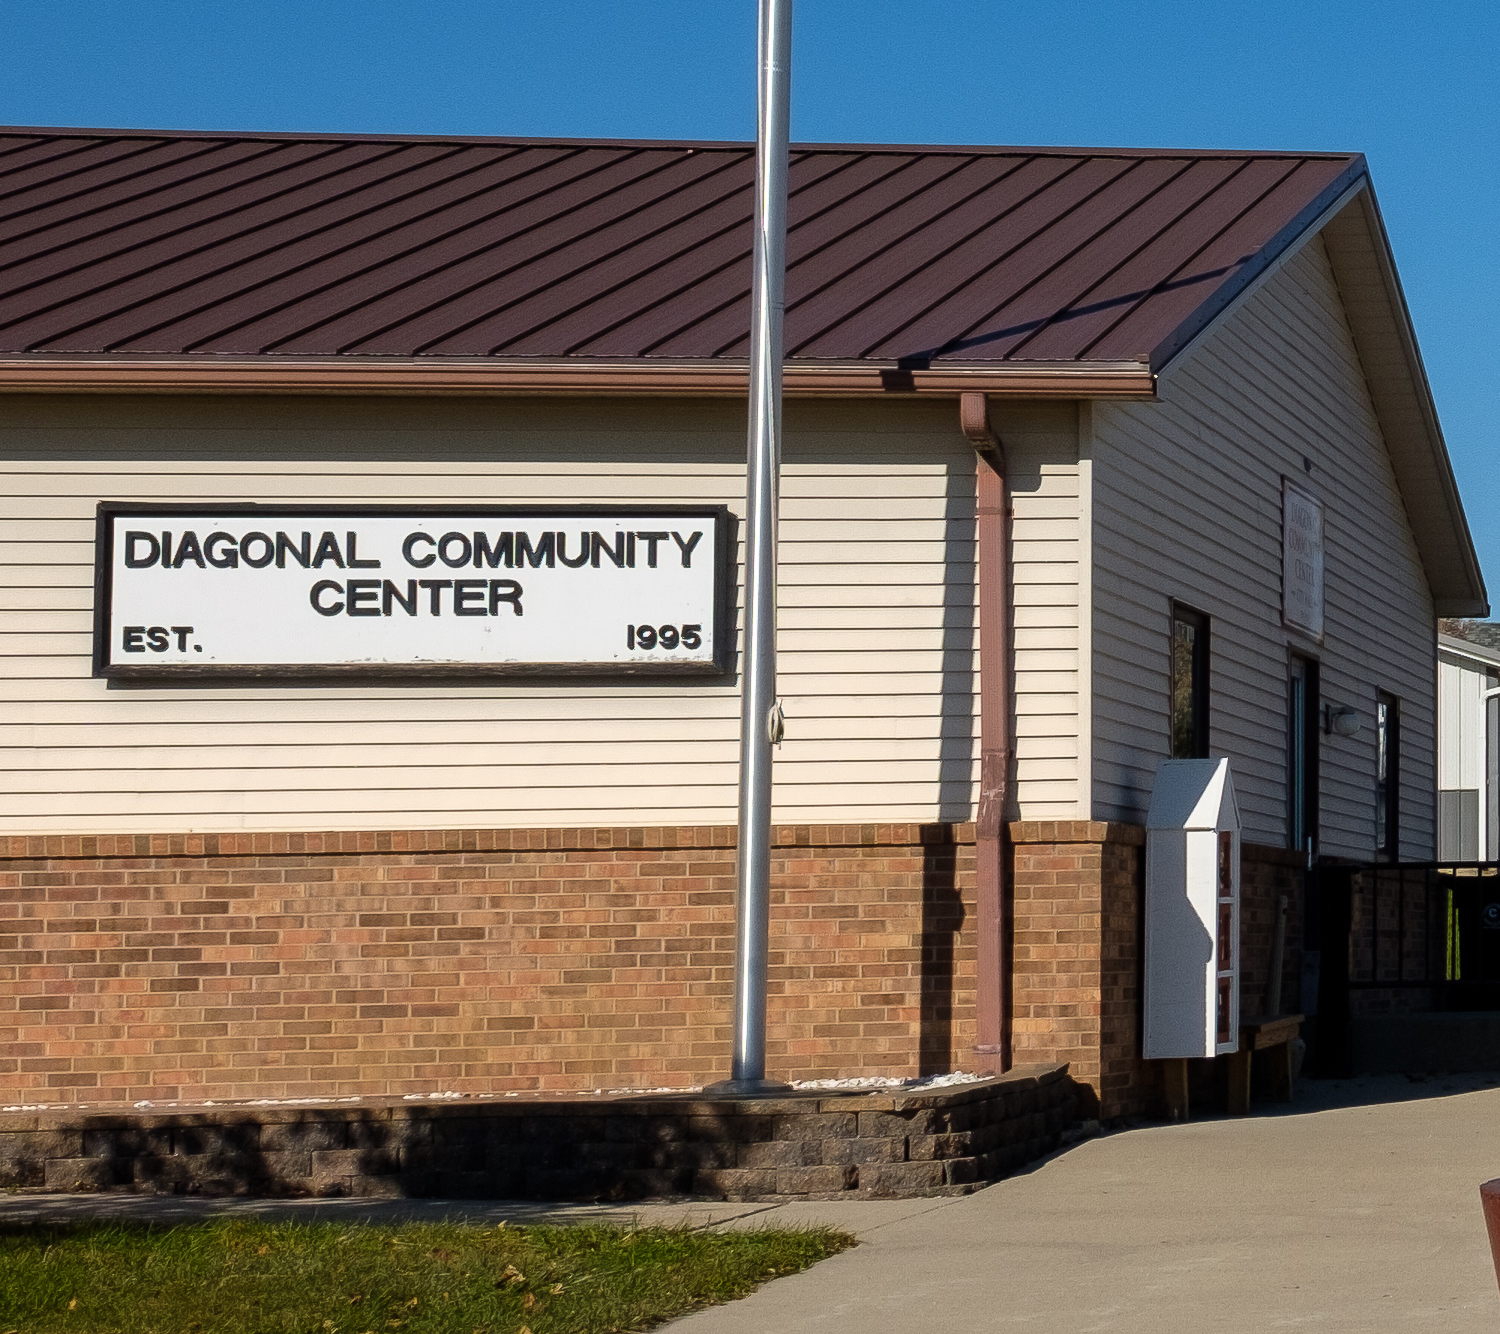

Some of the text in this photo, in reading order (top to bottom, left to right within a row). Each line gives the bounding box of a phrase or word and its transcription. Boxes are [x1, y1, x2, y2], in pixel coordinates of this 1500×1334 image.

[124, 531, 703, 569] DIAGONAL COMMUNITY
[309, 578, 524, 618] CENTER
[122, 624, 702, 653] EST. 1995
